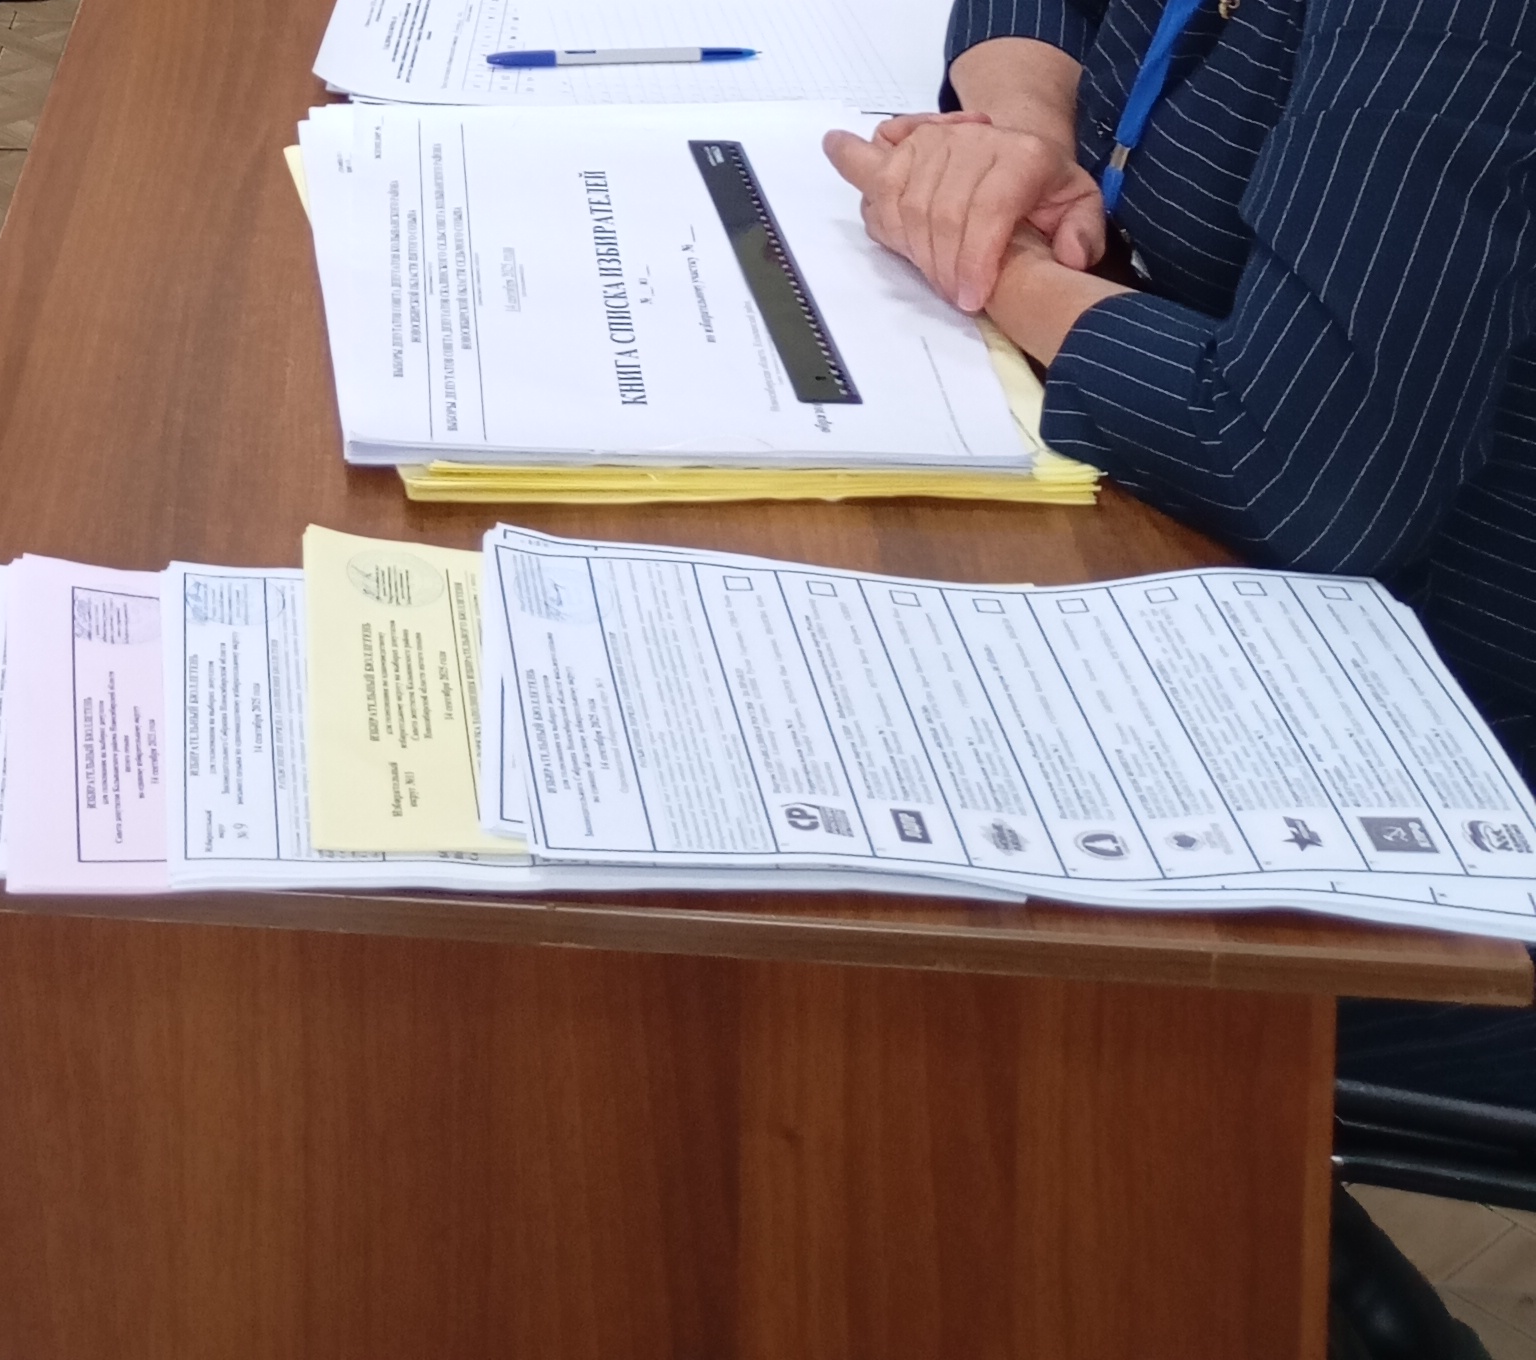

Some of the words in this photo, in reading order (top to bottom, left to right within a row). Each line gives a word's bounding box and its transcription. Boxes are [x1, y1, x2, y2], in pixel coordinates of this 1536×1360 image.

[578, 169, 624, 278] ИЗБИРАТЕЛЕЙ
[602, 282, 637, 345] СПИСКА
[613, 349, 648, 406] КНИГА
